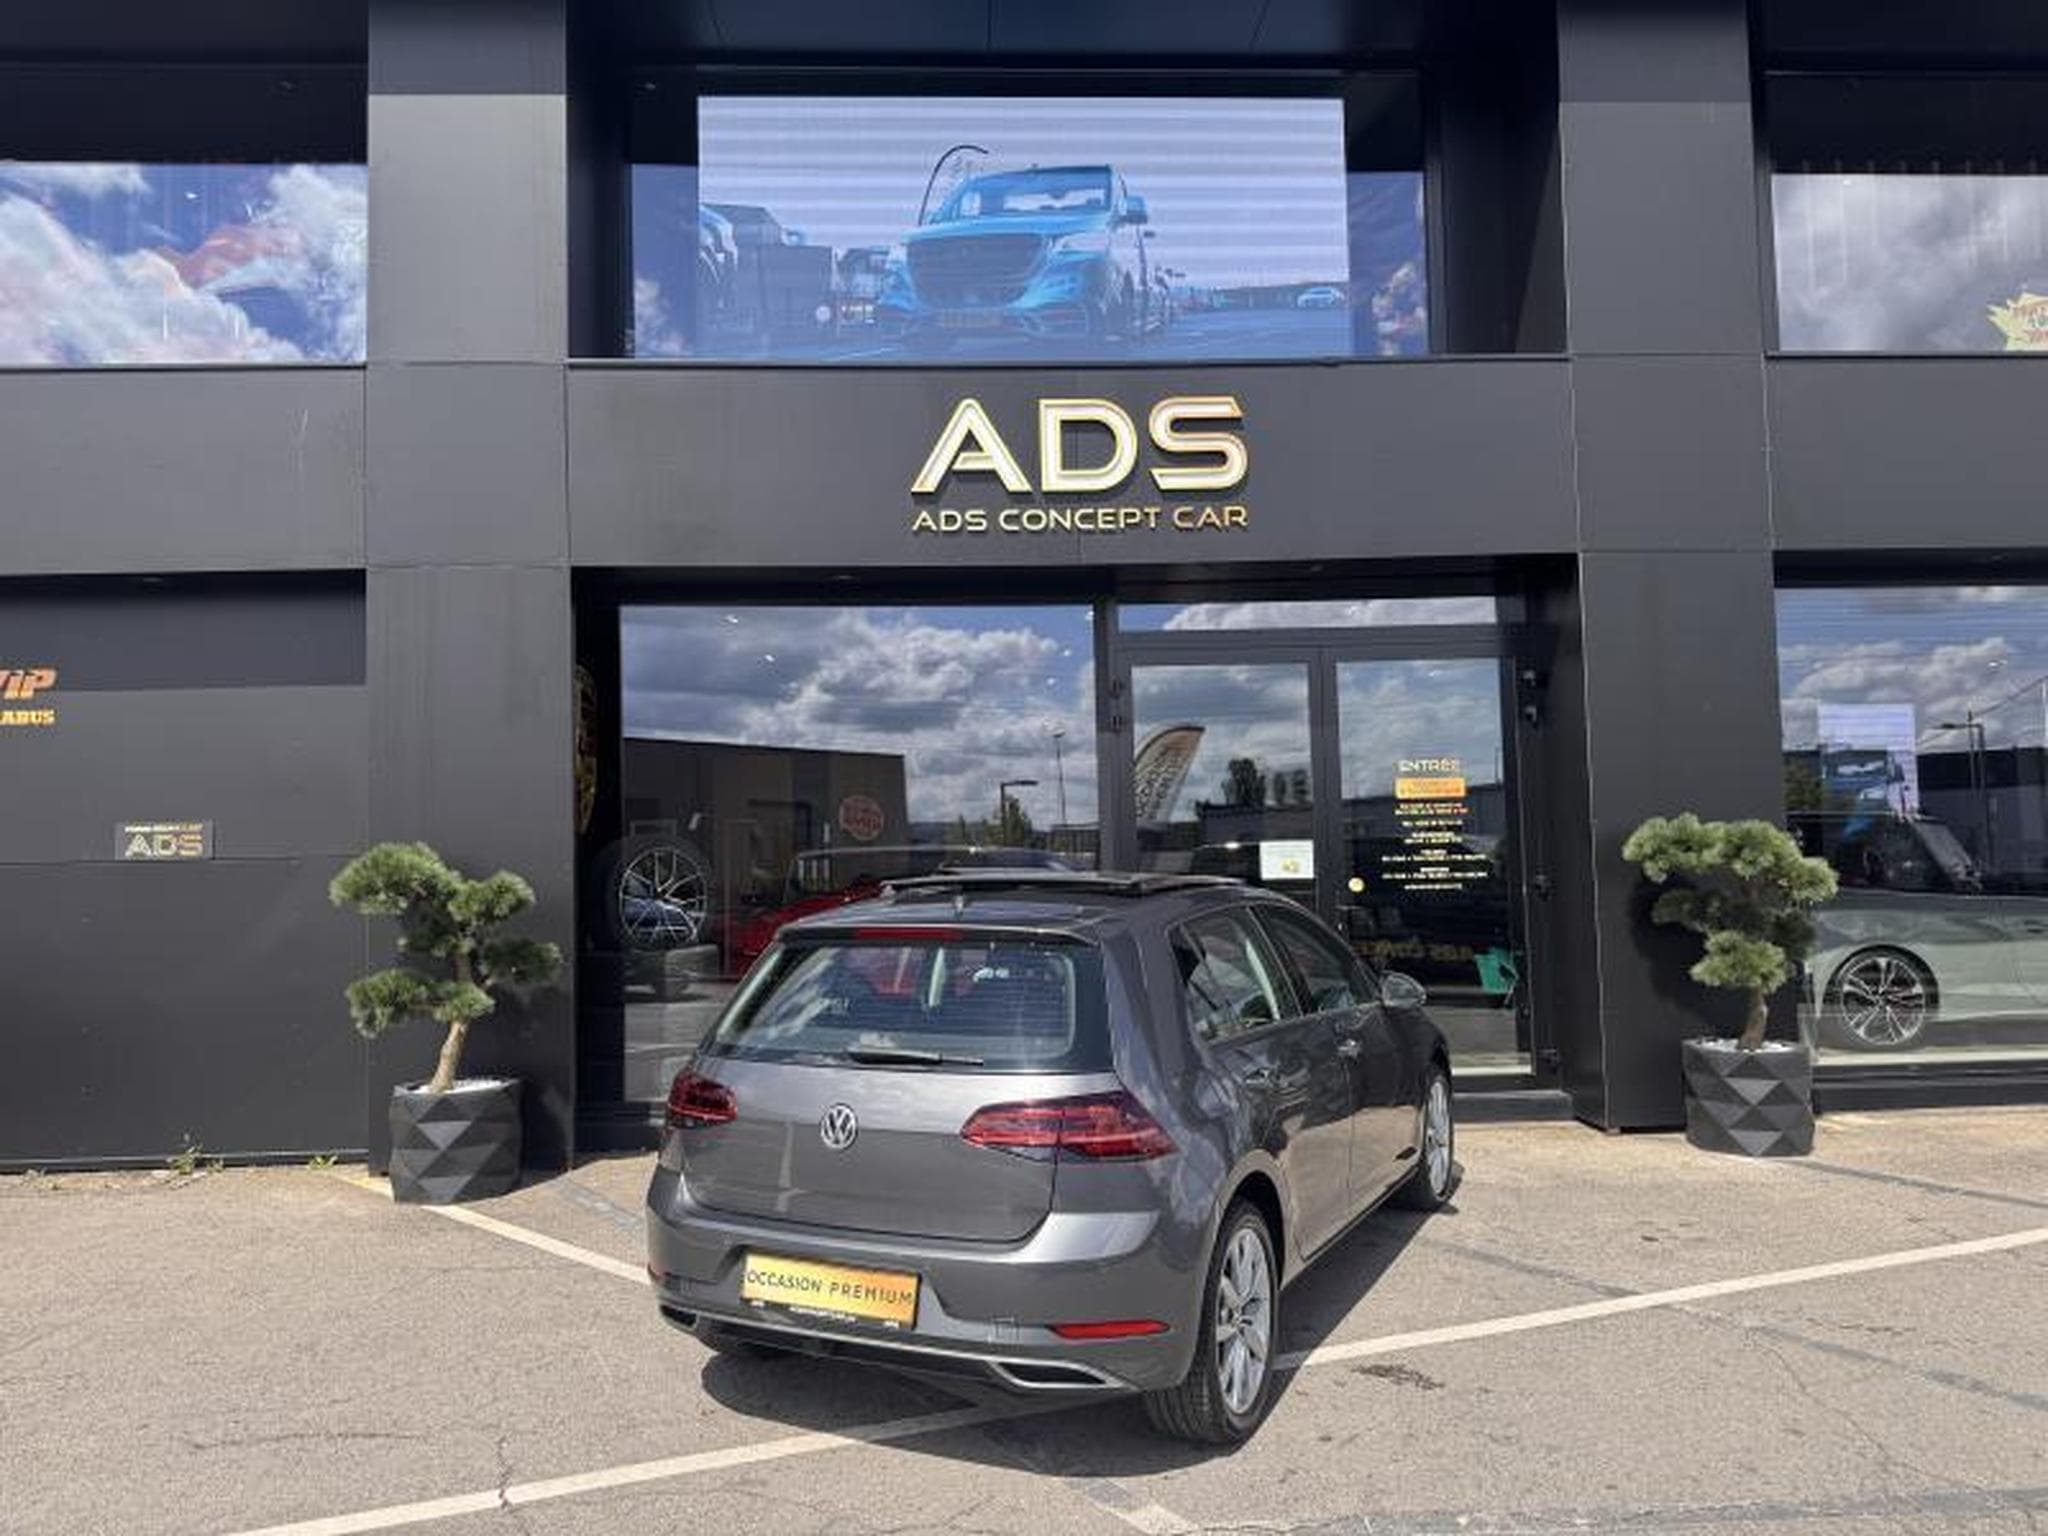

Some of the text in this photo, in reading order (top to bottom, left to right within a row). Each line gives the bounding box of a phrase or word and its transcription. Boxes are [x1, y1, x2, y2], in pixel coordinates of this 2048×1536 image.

[910, 396, 1249, 493] ADS
[912, 505, 1249, 532] ADS CONCEPT CAR
[125, 833, 203, 857] ADS
[745, 1269, 914, 1306] OCCASION PREMIUM
